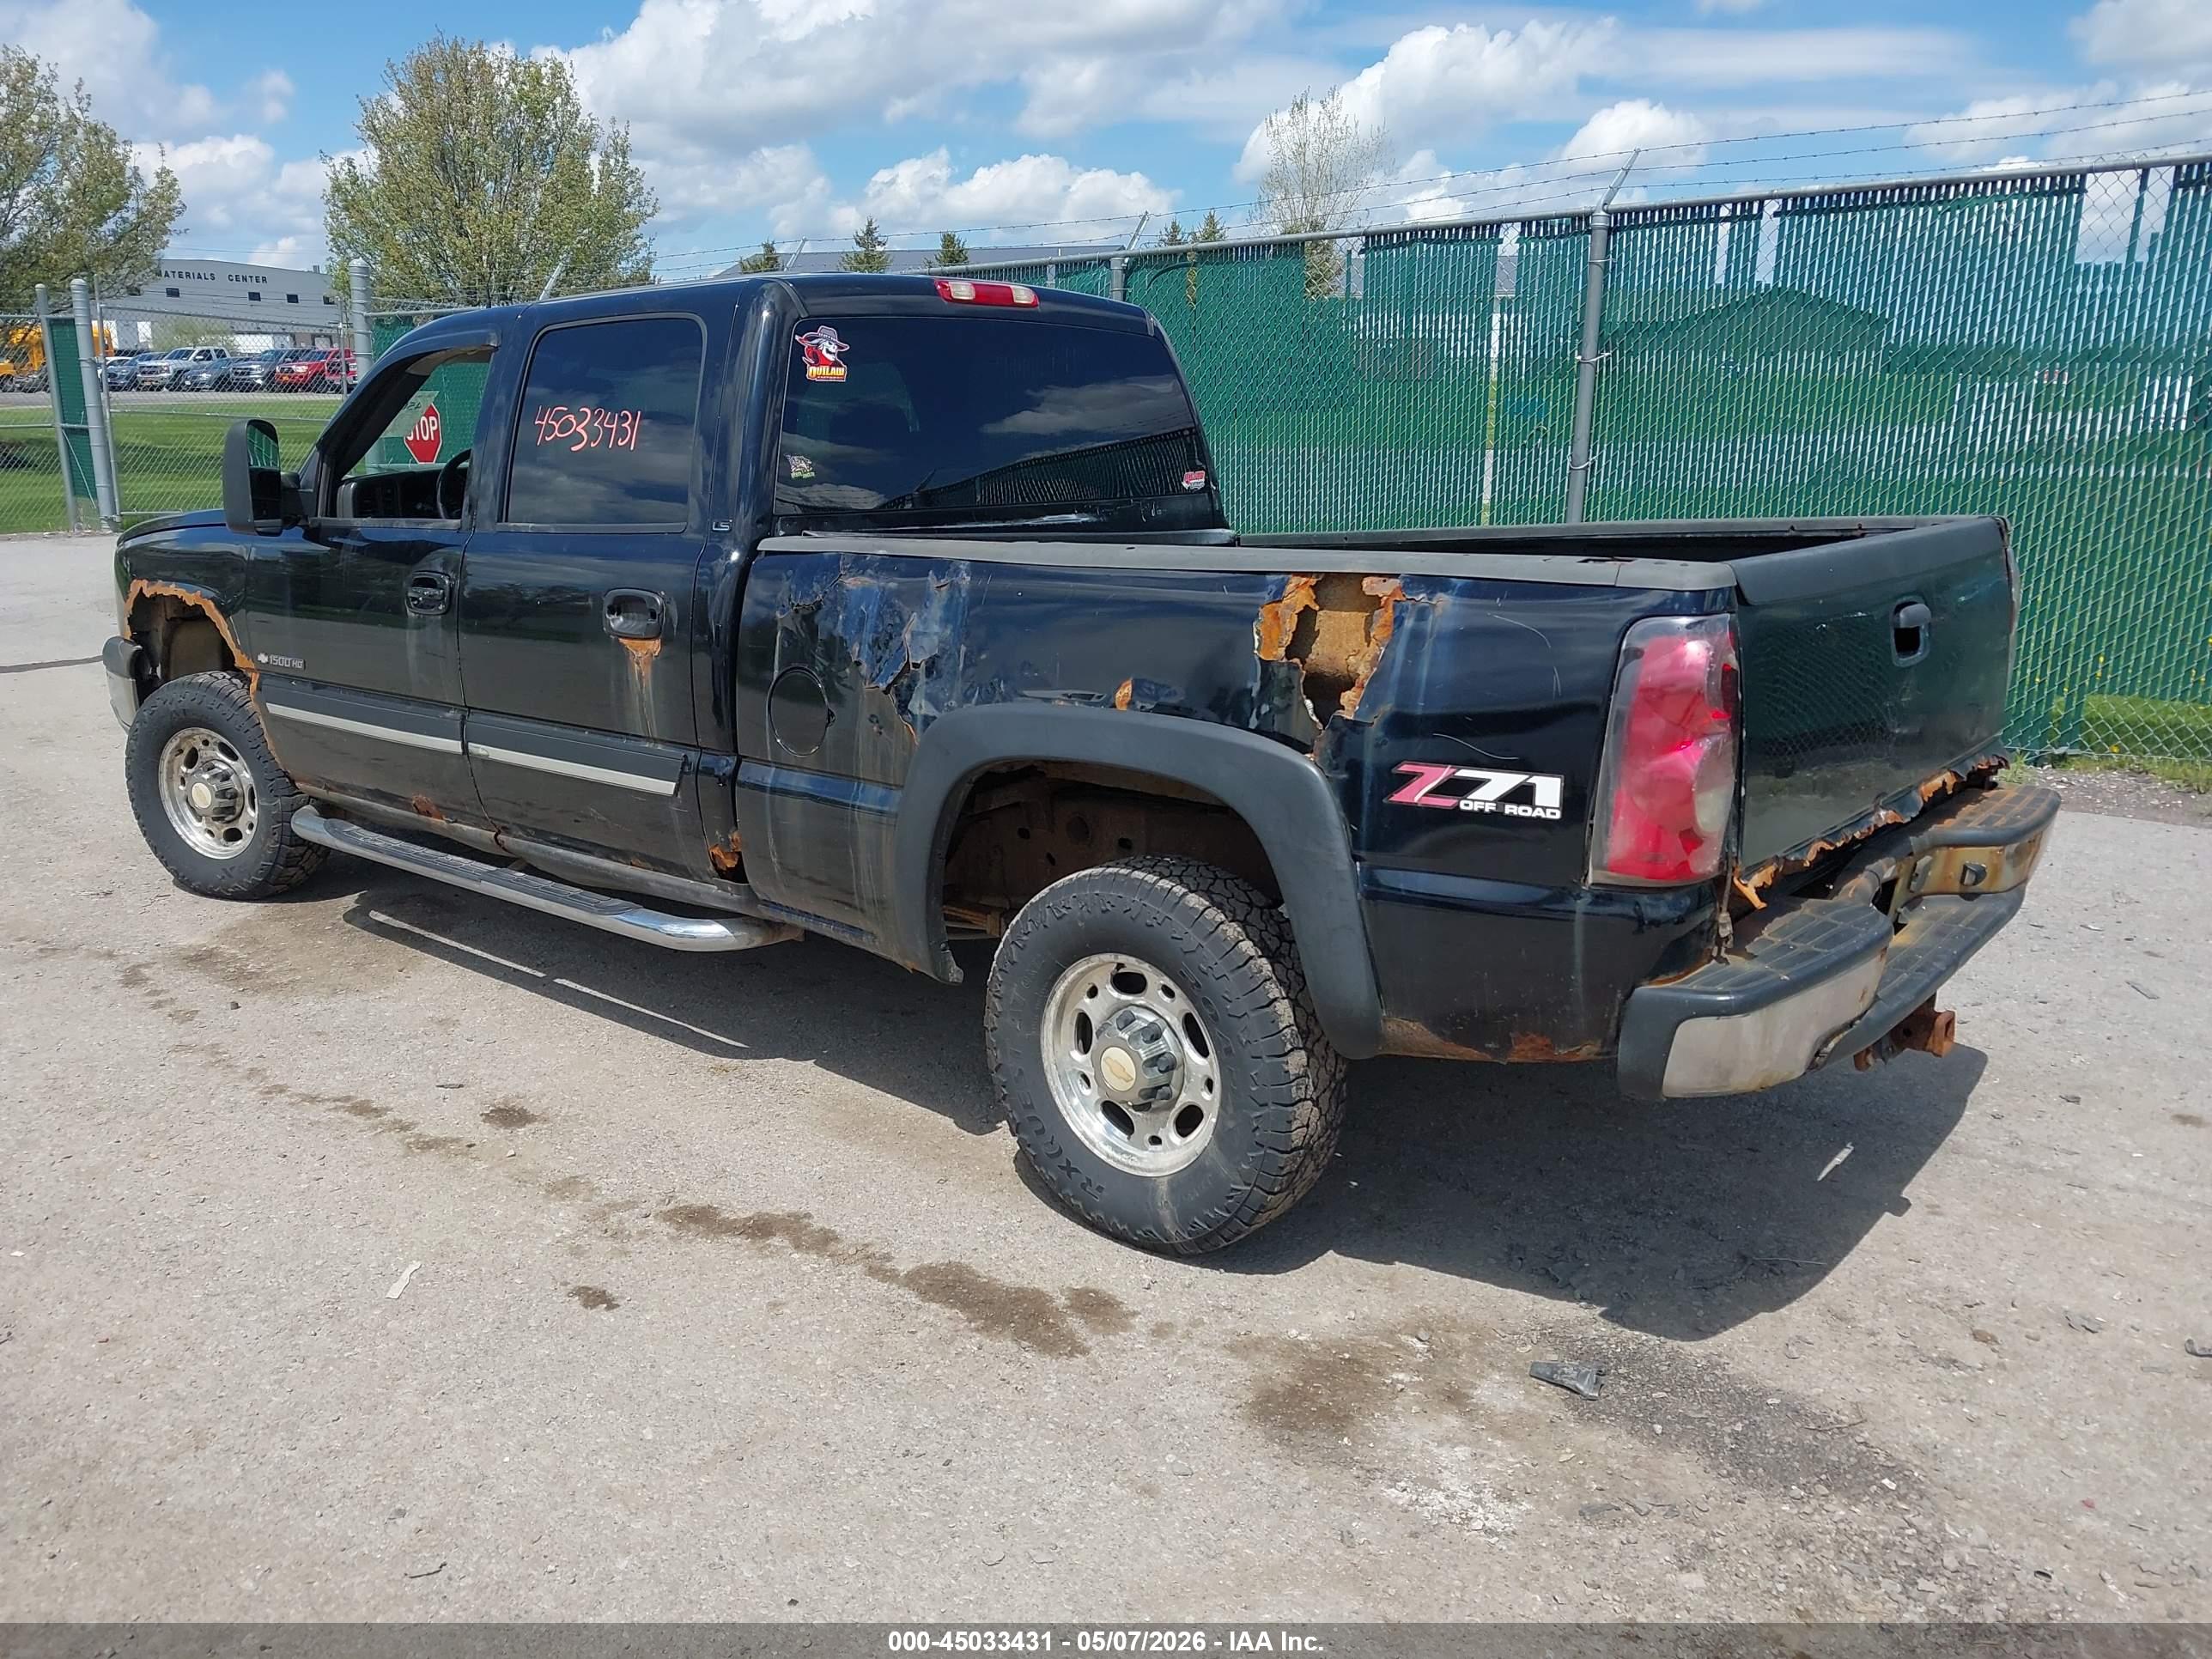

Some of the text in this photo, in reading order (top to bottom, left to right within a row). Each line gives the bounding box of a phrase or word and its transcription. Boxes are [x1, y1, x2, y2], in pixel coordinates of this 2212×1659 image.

[228, 274, 268, 283] CENTER
[535, 405, 641, 451] 45033431
[1388, 763, 1562, 808] Z71
[1460, 799, 1562, 819] OFF ROAD
